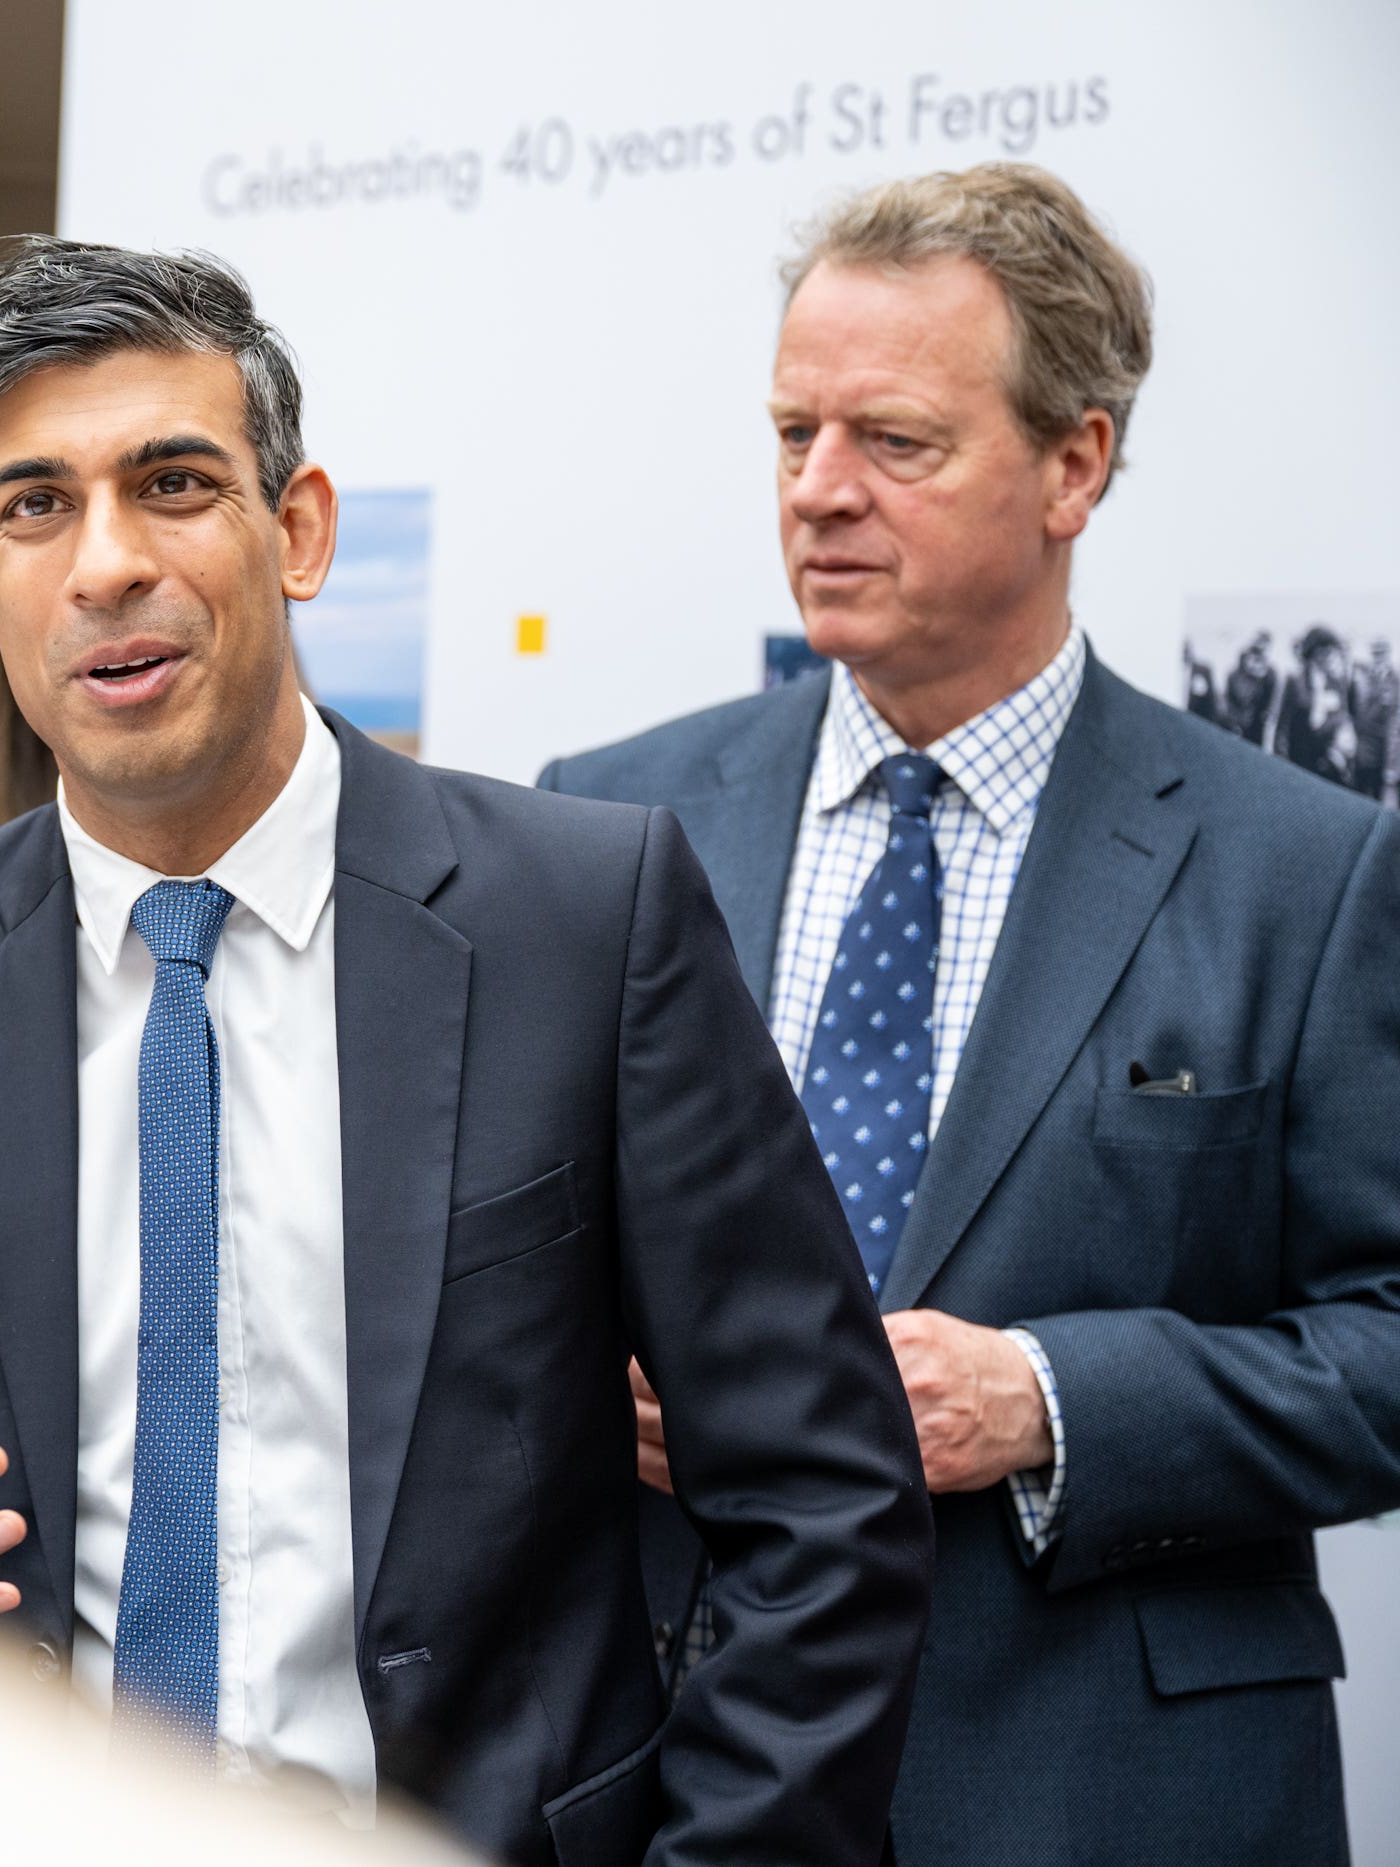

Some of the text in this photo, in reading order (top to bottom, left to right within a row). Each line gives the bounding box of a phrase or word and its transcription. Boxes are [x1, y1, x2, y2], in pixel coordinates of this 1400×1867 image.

[204, 72, 1111, 217] Celebrating 40 years of St Fergus
